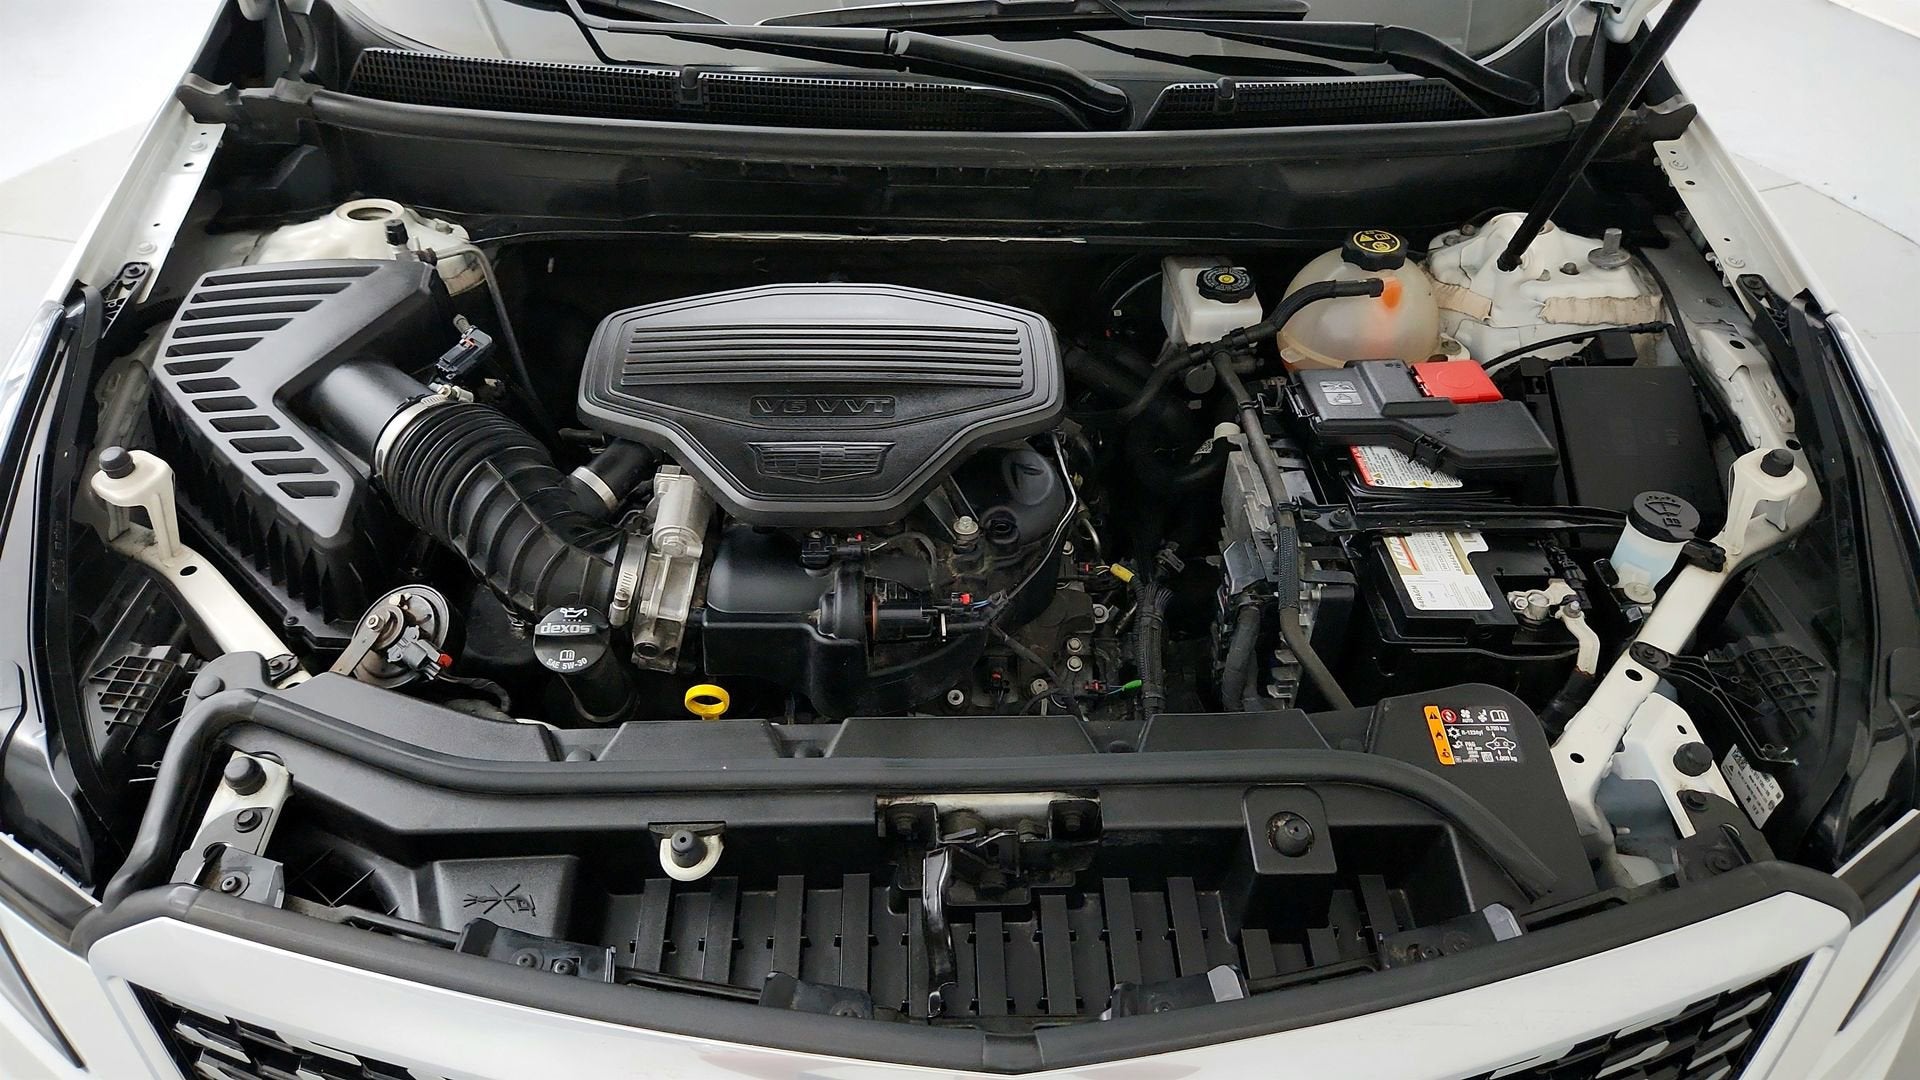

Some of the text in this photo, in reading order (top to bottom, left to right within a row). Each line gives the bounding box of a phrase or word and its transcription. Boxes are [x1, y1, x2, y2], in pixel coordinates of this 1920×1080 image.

[756, 398, 893, 413] V6 VVT
[540, 623, 592, 634] dexos
[546, 657, 588, 670] SAE 5W-30
